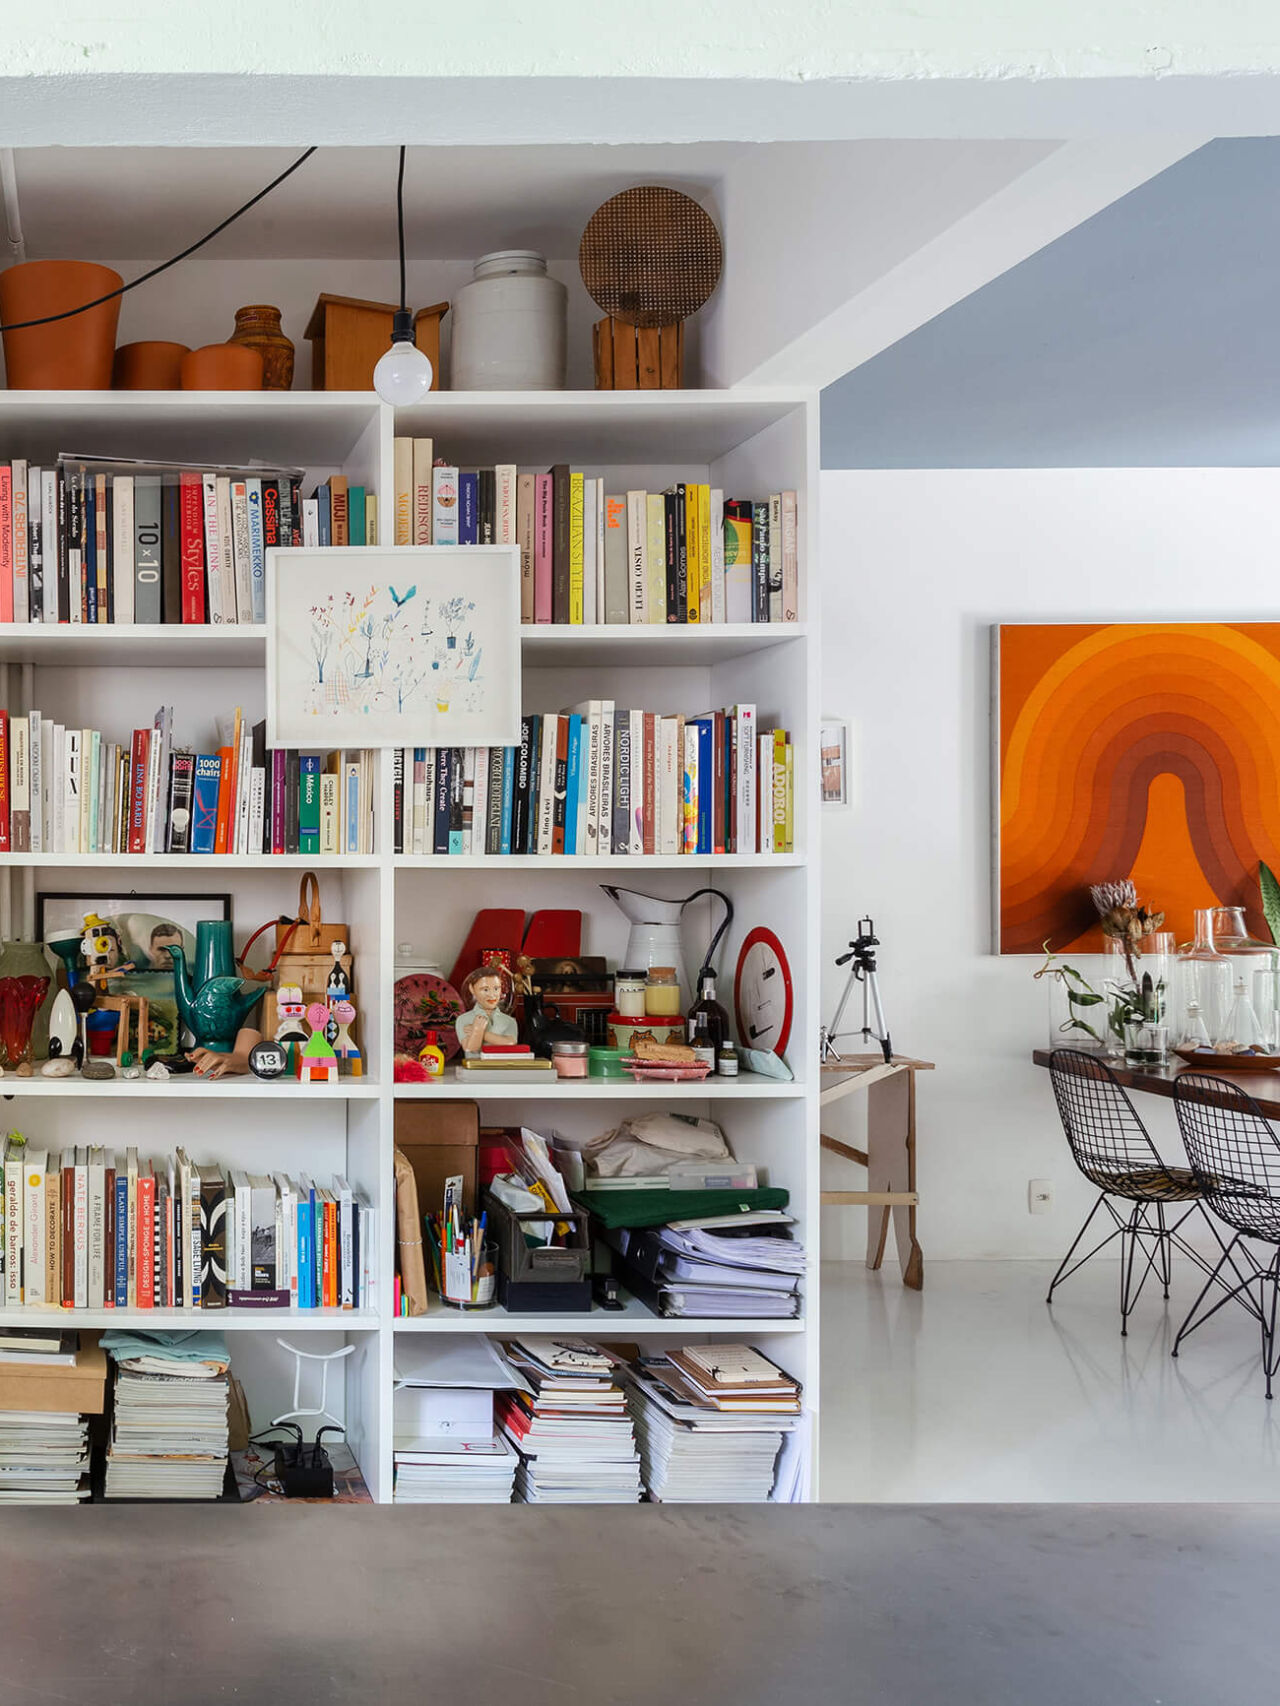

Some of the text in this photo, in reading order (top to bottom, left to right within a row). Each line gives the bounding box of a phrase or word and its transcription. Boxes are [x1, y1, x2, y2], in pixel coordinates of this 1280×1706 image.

[0, 475, 12, 569] Living with Modernity
[138, 522, 159, 546] 10
[207, 495, 220, 574] IN THE PINK
[264, 488, 278, 545] Cassina
[333, 493, 346, 523] MUJI
[182, 537, 203, 591] Styles
[250, 508, 263, 578] MARIMEKKO
[138, 559, 159, 583] 10
[633, 545, 643, 610] LUCIO COSTA
[196, 768, 221, 777] chairs
[198, 759, 221, 768] 1000
[519, 722, 529, 790] JOE COLOMBO
[589, 724, 599, 777] BRASILEIRAS
[620, 729, 630, 811] NORDIC LIGHT
[133, 763, 144, 828] LINA BO BARDI
[306, 774, 315, 804] México
[425, 762, 434, 802] bauhaus
[438, 768, 448, 812] They Create
[600, 764, 611, 818] BRASILEIRAS
[773, 762, 786, 826] ADORO!
[541, 797, 552, 836] Rino Levi
[260, 1053, 277, 1066] 13
[28, 1193, 39, 1264] Alexander Girard
[77, 1173, 86, 1251] NATE BERKUS
[91, 1202, 102, 1229] FRAME
[142, 1193, 151, 1217] HOME
[6, 1180, 19, 1289] geraldo de barros: isso
[49, 1240, 56, 1252] TO
[91, 1228, 102, 1243] FOR
[91, 1243, 102, 1260] LIFE
[117, 1191, 126, 1273] PLAIN SIMPLE USEFUL
